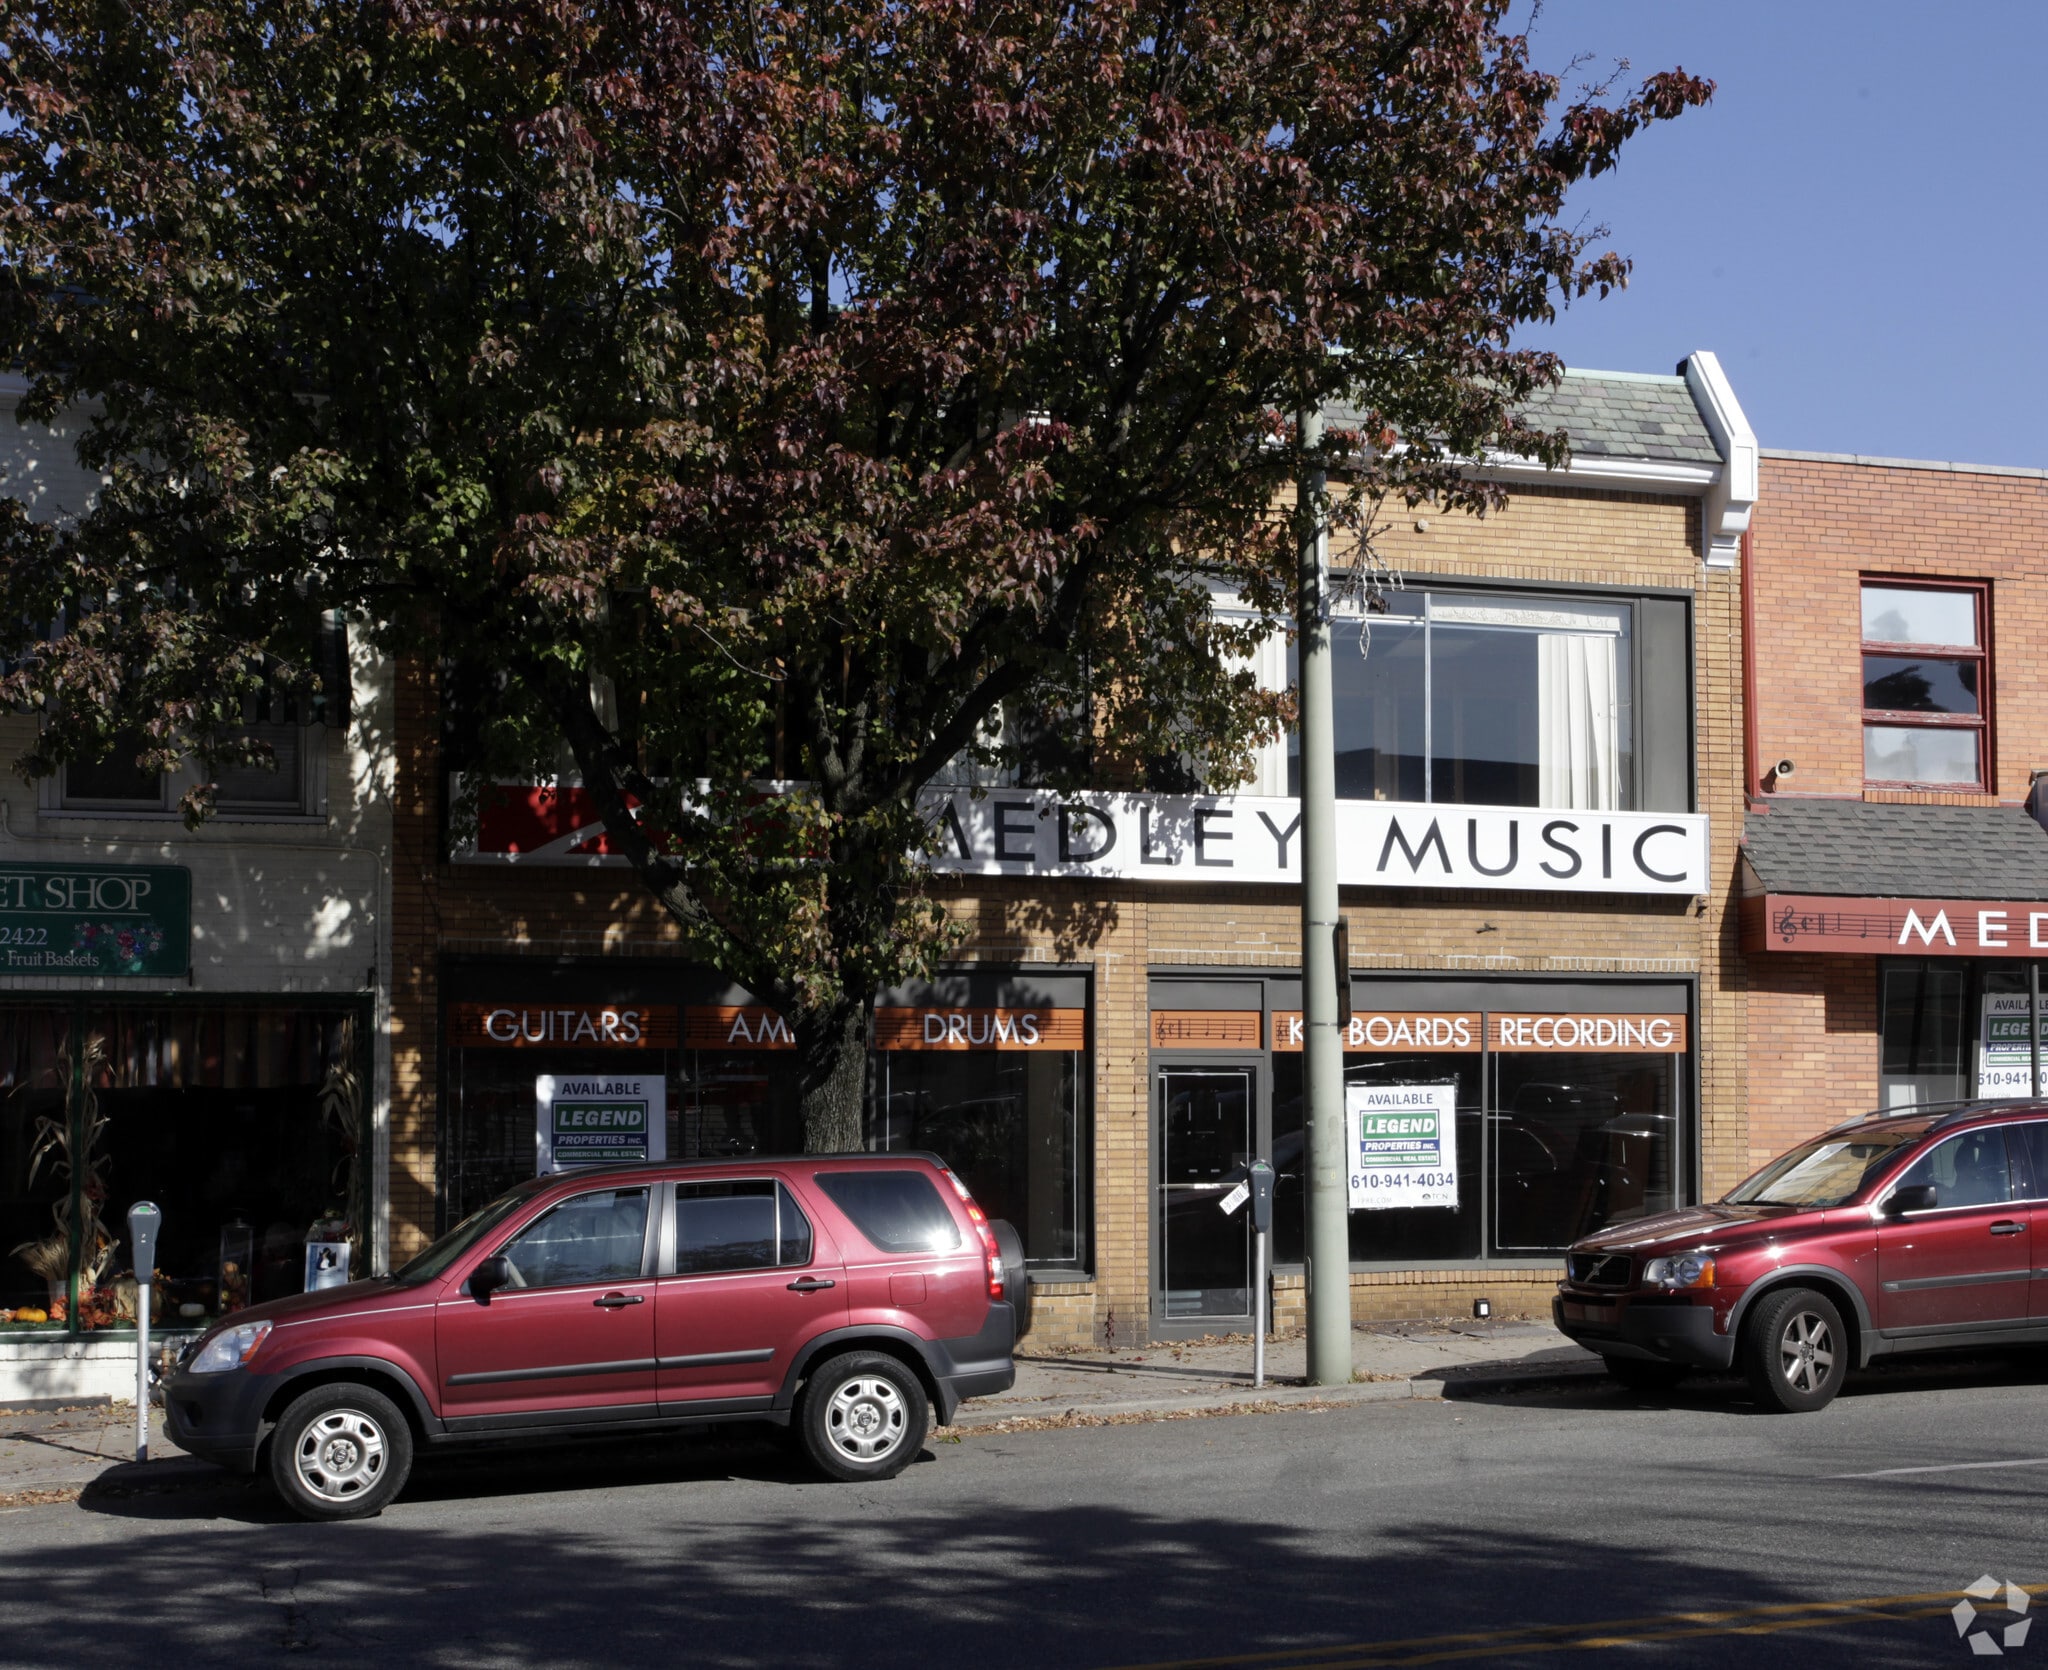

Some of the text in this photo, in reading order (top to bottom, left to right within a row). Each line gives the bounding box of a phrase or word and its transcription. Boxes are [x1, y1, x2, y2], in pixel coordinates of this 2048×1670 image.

[1376, 814, 1688, 883] MUSIC
[45, 877, 152, 910] SHOP
[0, 927, 48, 945] 2422
[7, 950, 100, 967] Fruit Baskets
[1995, 1000, 2048, 1011] AVAILALE
[486, 1009, 640, 1043] GUITARS
[727, 1012, 796, 1043] AM
[924, 1013, 1039, 1046] DRUMS
[1289, 1016, 1471, 1047] KBOARDS
[1501, 1016, 1673, 1048] RECORDING
[1992, 1022, 2048, 1036] LEGED
[562, 1083, 641, 1095] AVAILABLE
[1368, 1093, 1433, 1105] AVAILABLE
[560, 1110, 642, 1126] LEGEND
[1366, 1118, 1435, 1134] LEGEND
[558, 1135, 625, 1144] PROPERTIES
[1365, 1141, 1421, 1151] PROPERTIES
[1351, 1172, 1454, 1189] 610-941-4034
